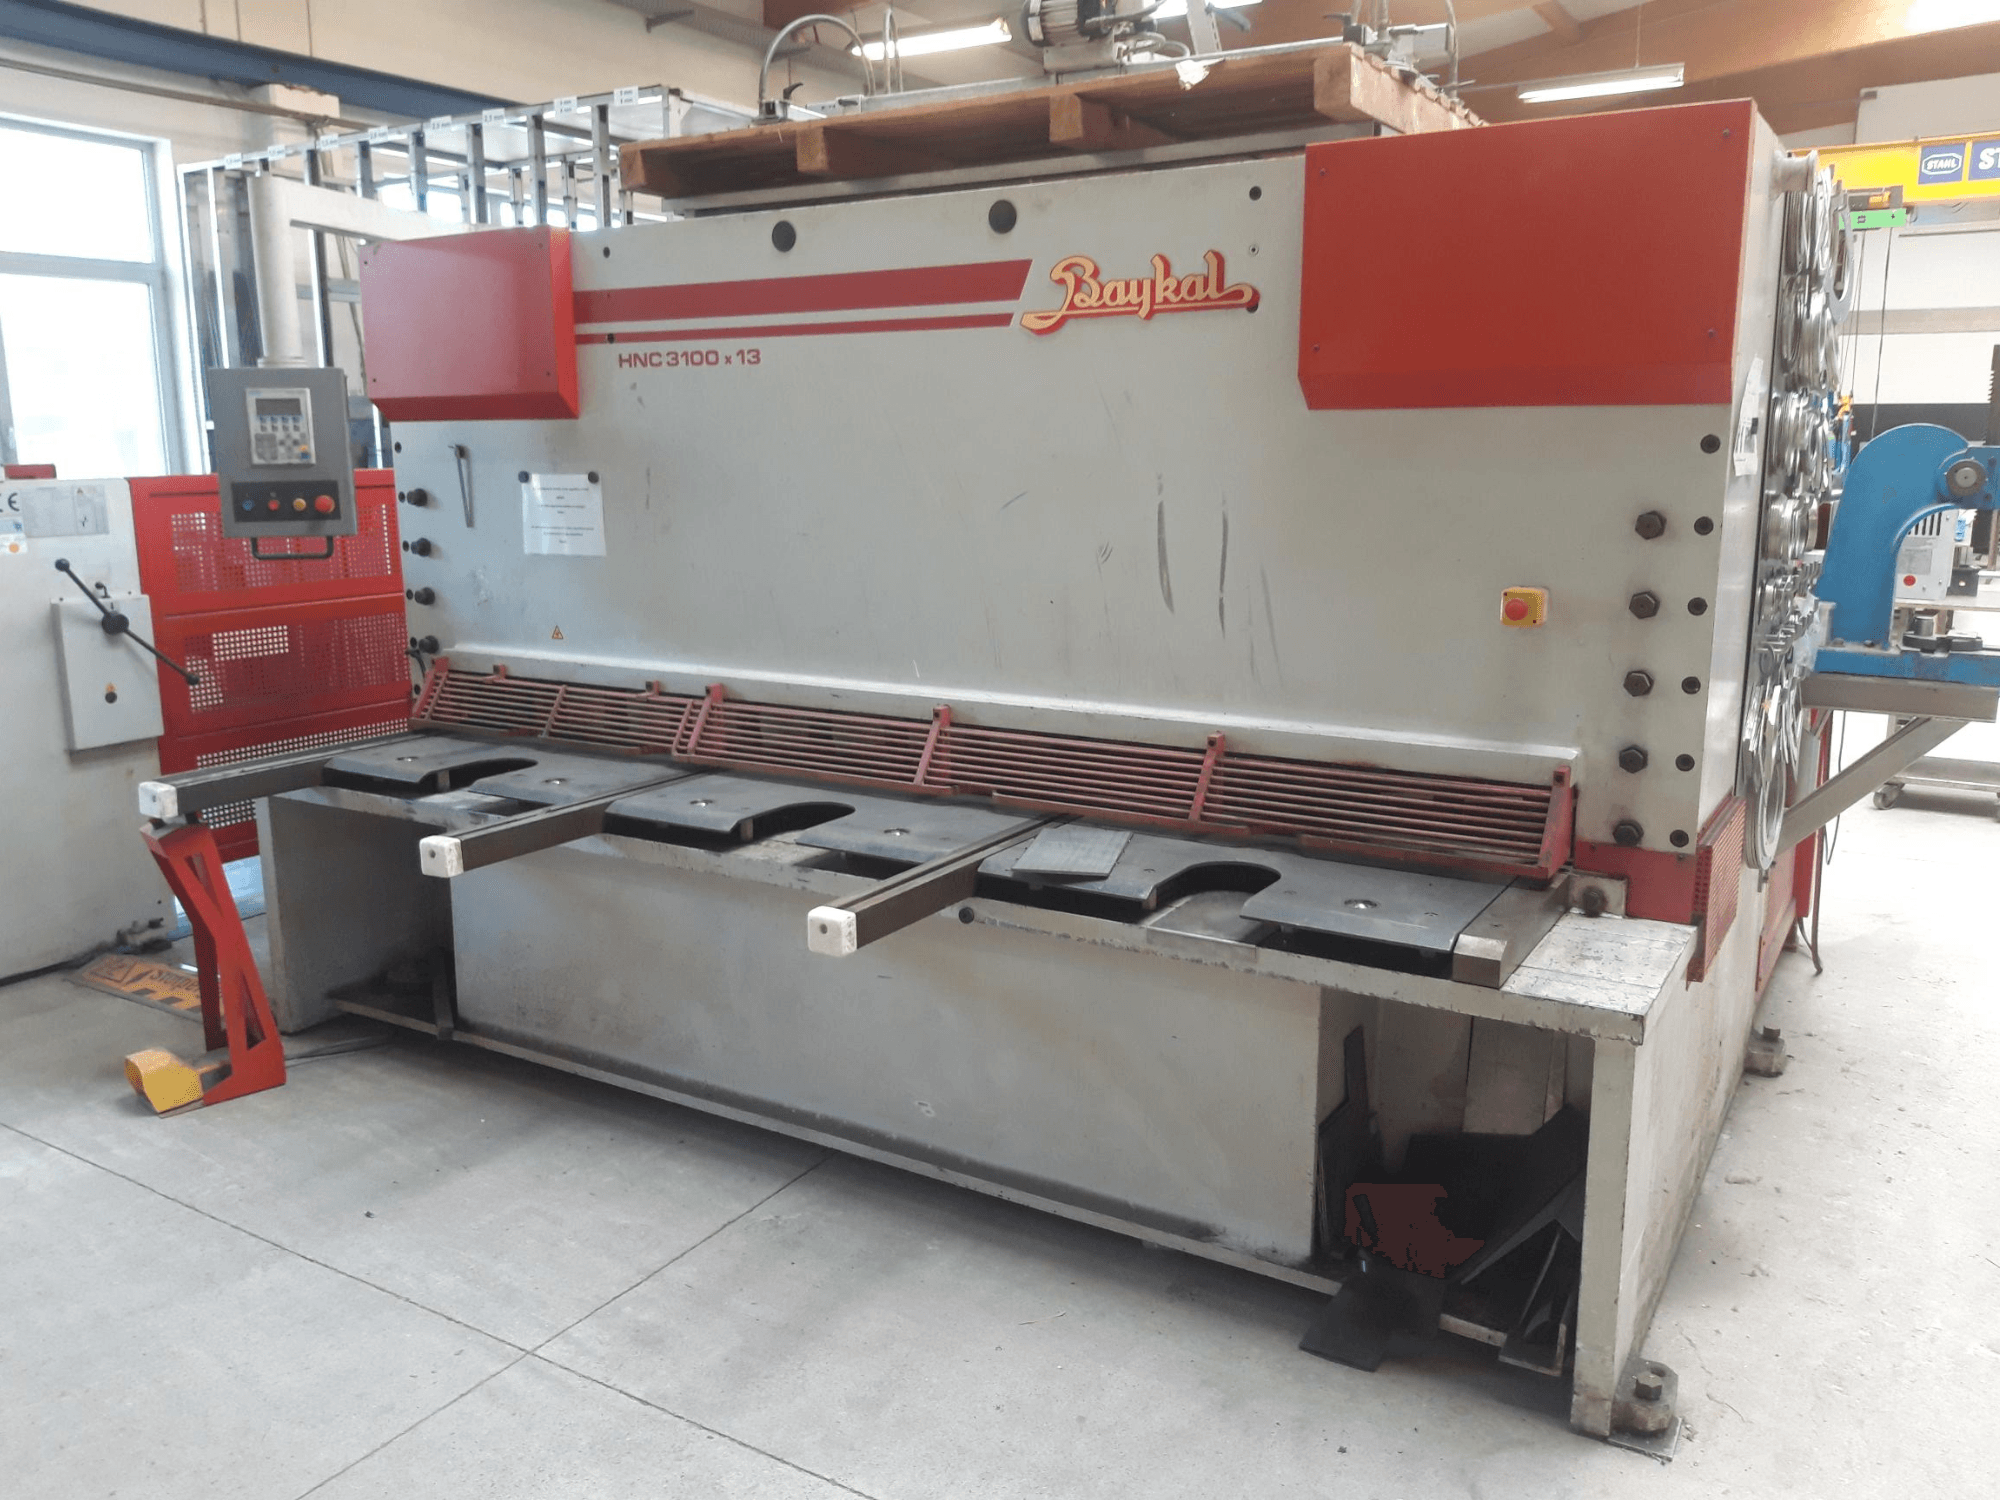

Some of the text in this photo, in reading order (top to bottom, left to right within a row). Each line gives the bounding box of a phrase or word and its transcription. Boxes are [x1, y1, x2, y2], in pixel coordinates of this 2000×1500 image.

[1926, 158, 1958, 170] STAHL
[1020, 249, 1260, 335] Baykal
[618, 352, 663, 368] HNC
[665, 349, 720, 367] 3100
[736, 348, 762, 366] 13
